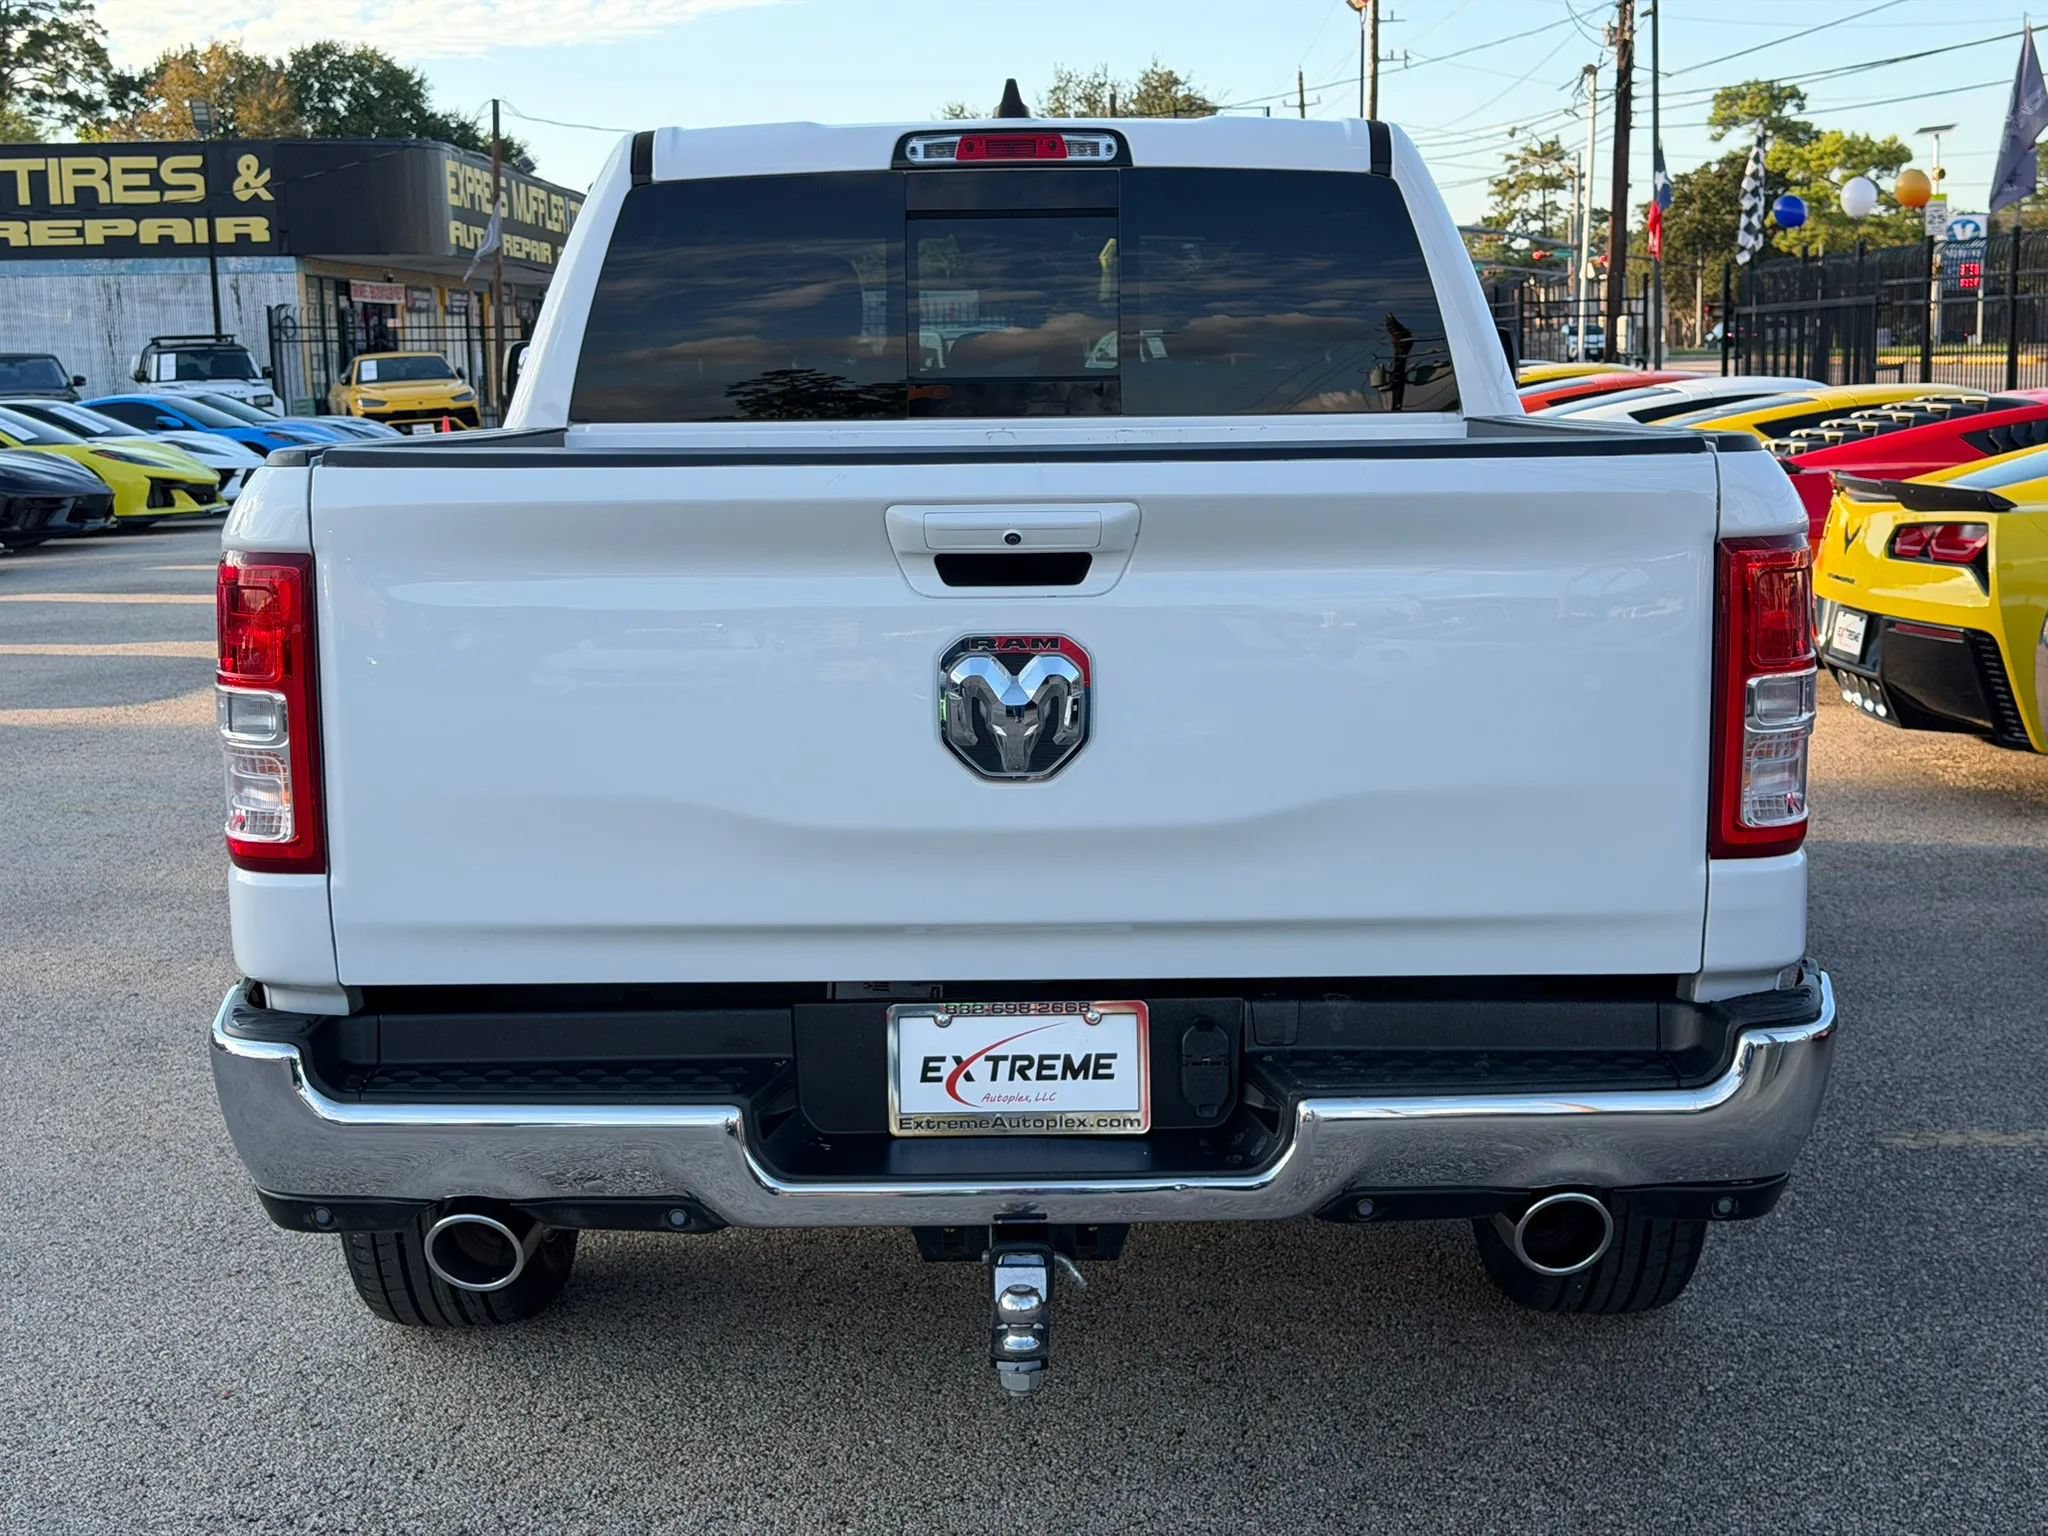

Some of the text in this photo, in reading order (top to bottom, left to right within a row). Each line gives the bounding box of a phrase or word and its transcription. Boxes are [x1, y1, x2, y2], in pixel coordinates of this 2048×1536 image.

[0, 154, 275, 206] TIRES &
[511, 179, 567, 234] MUFFLER
[449, 220, 486, 250] AUT
[502, 233, 553, 264] REPAIR
[969, 636, 1060, 651] RAM
[945, 1002, 1091, 1015] 832-698-2668
[919, 1052, 1118, 1084] EXTREME
[981, 1091, 1057, 1105] Autoplex, LLC
[899, 1116, 1142, 1132] ExtremeAutoplex.com
